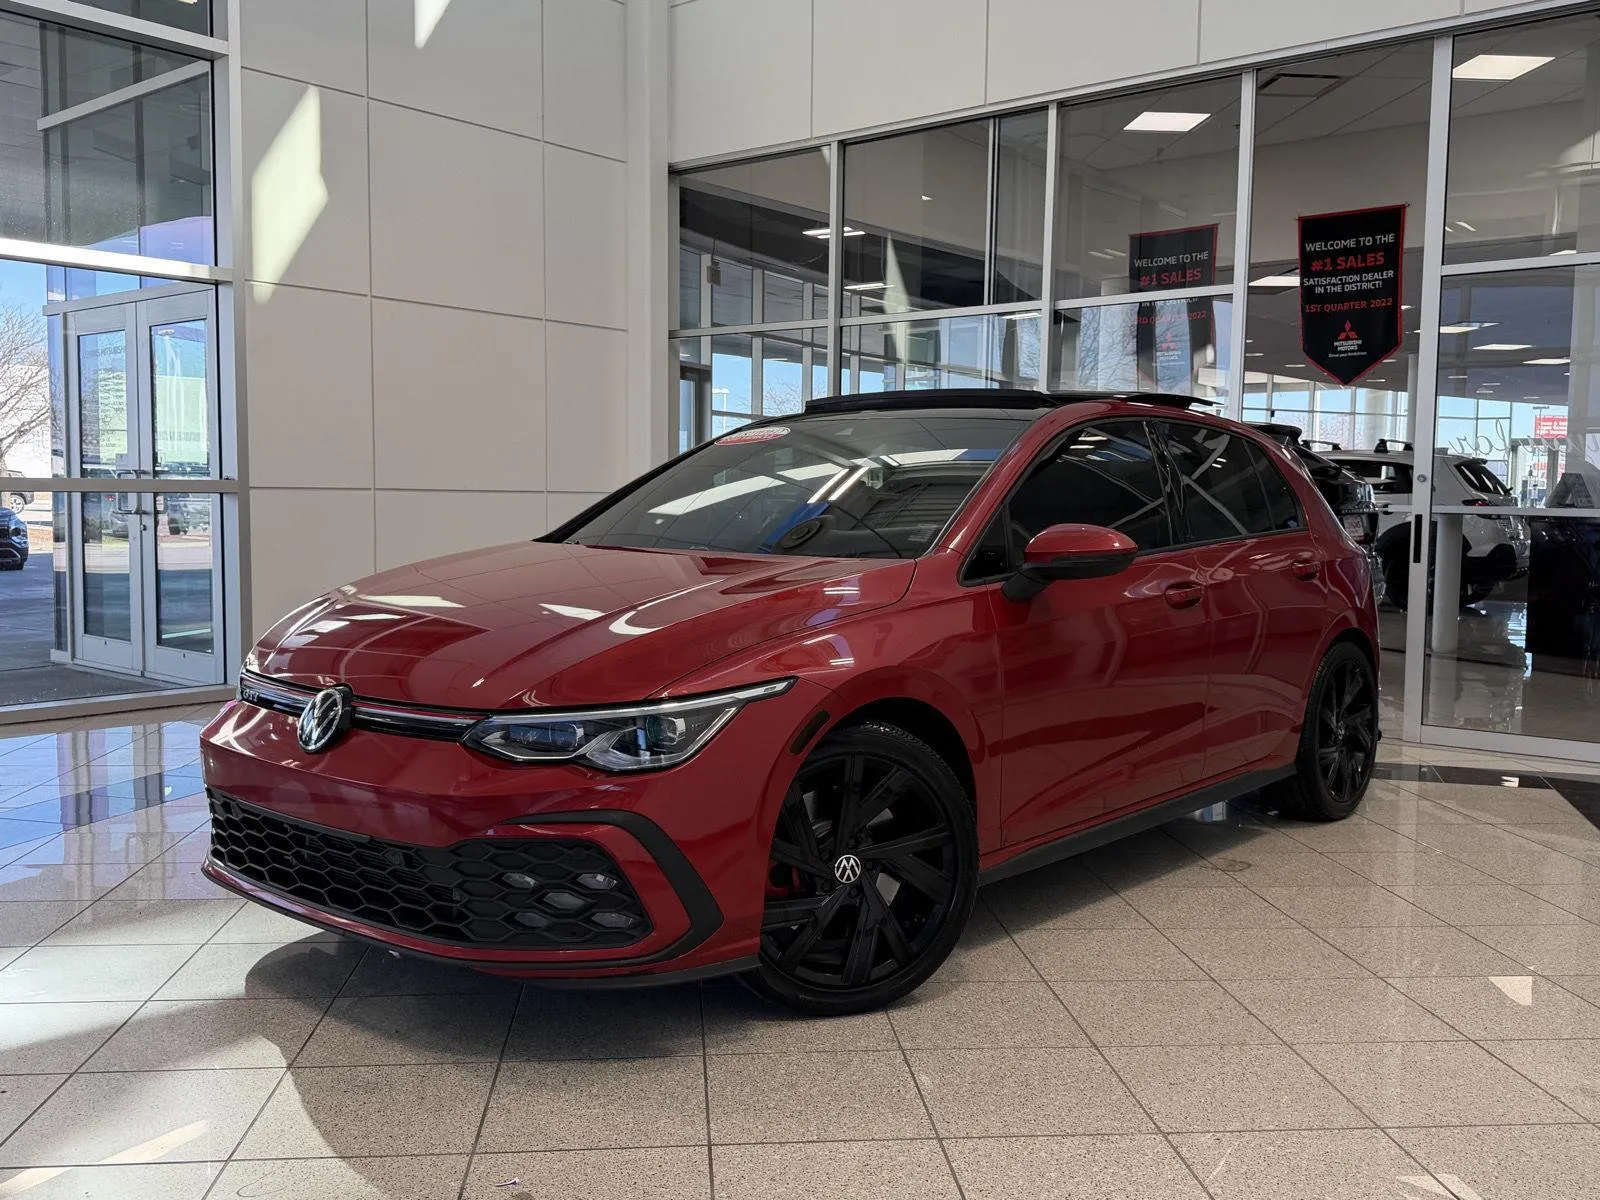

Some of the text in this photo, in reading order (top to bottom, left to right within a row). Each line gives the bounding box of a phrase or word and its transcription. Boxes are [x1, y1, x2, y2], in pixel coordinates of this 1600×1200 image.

[1305, 233, 1395, 252] WELCOME TO THE
[1134, 251, 1209, 268] WELCOME TO THE
[1311, 252, 1385, 272] #1 SALES
[1139, 268, 1202, 286] #1 SALES
[1303, 270, 1394, 286] SATISFACTION DEALER
[1315, 281, 1383, 294] IN THE DISTRICT!
[1305, 297, 1393, 313] 1ST QUARTER 2022
